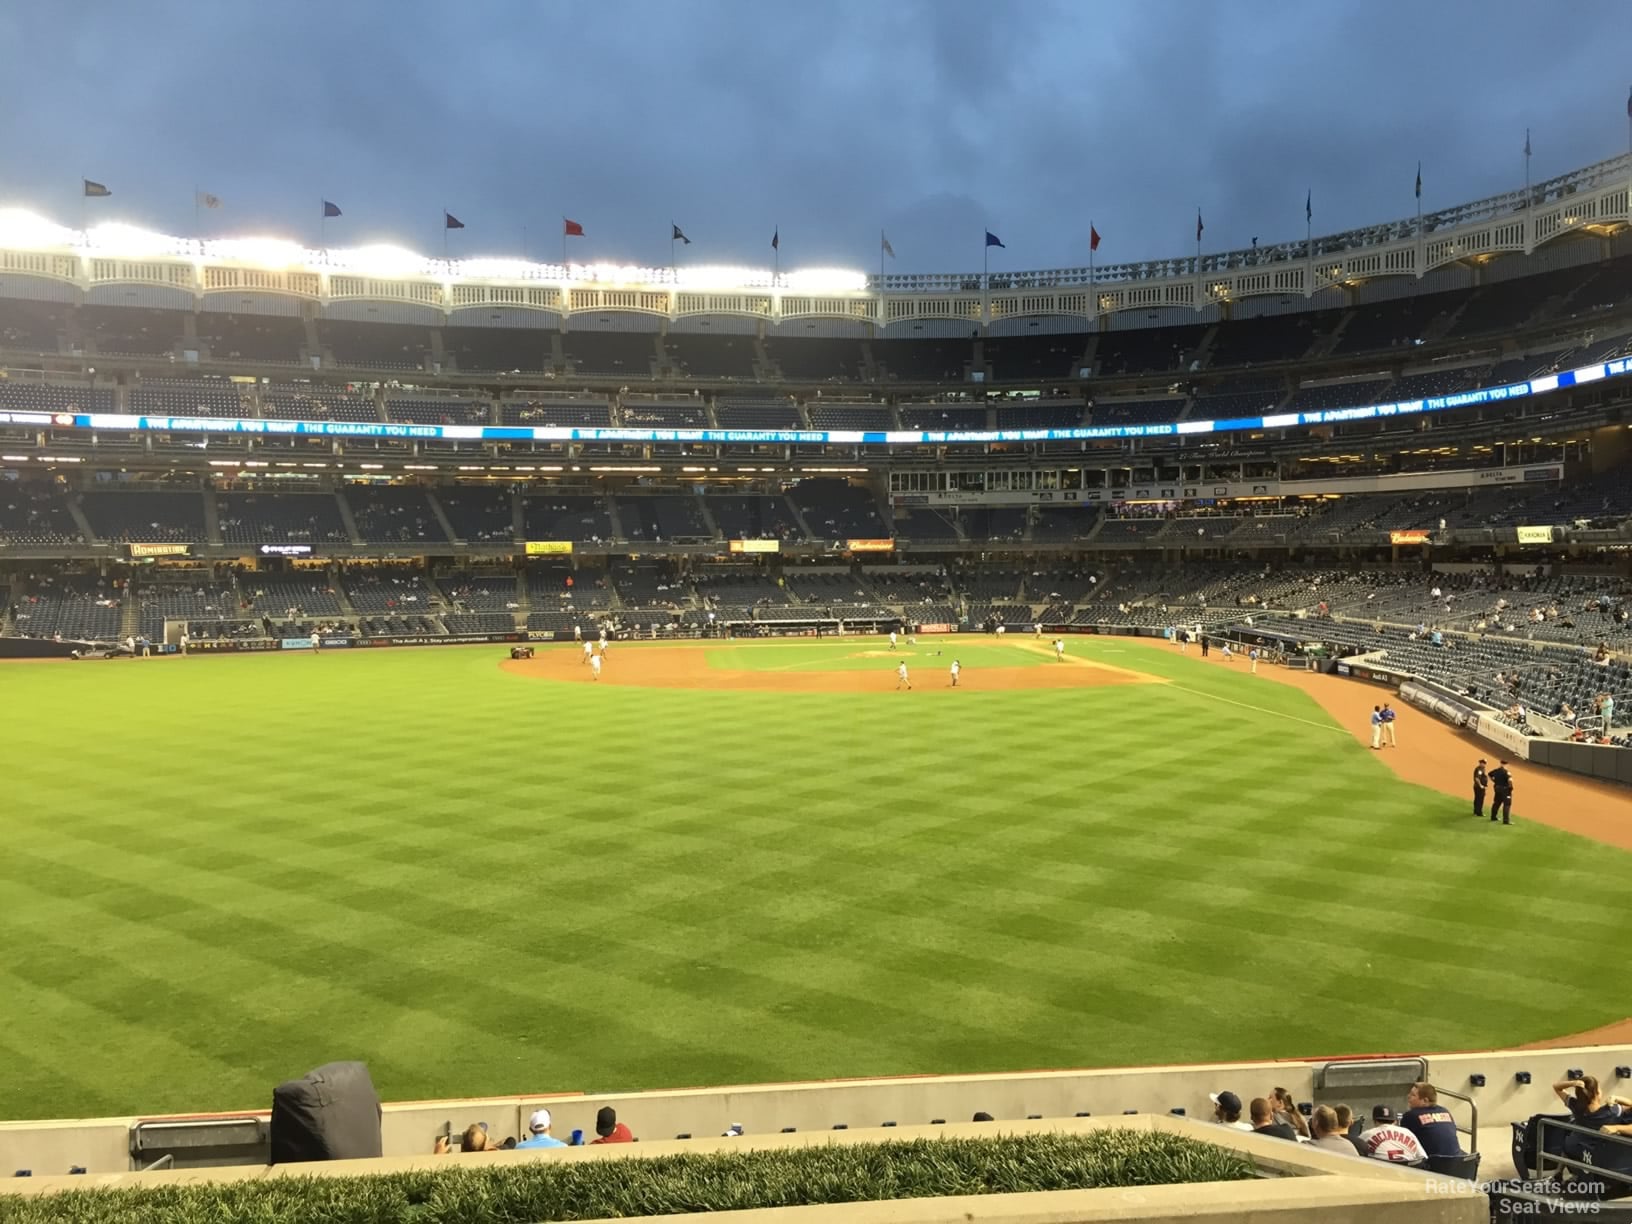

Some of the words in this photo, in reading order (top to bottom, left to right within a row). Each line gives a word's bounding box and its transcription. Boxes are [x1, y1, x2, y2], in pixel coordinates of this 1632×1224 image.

[1428, 398, 1445, 409] THE
[1446, 391, 1488, 407] GUARANTY
[1489, 388, 1507, 399] YOU
[1508, 384, 1529, 396] NEED
[304, 424, 324, 433] THE
[327, 424, 383, 434] GUARANTY
[385, 427, 407, 435] YOU
[409, 427, 436, 436] NEED
[709, 432, 725, 441] THE
[728, 432, 774, 441] GUARANTY
[779, 432, 797, 441] YOU
[799, 433, 823, 441] NEED
[1002, 431, 1020, 440] YOU
[1054, 430, 1071, 439] THE
[1073, 427, 1121, 438] GUARANTY
[1124, 426, 1143, 435] YOU
[1146, 425, 1172, 434] NEED
